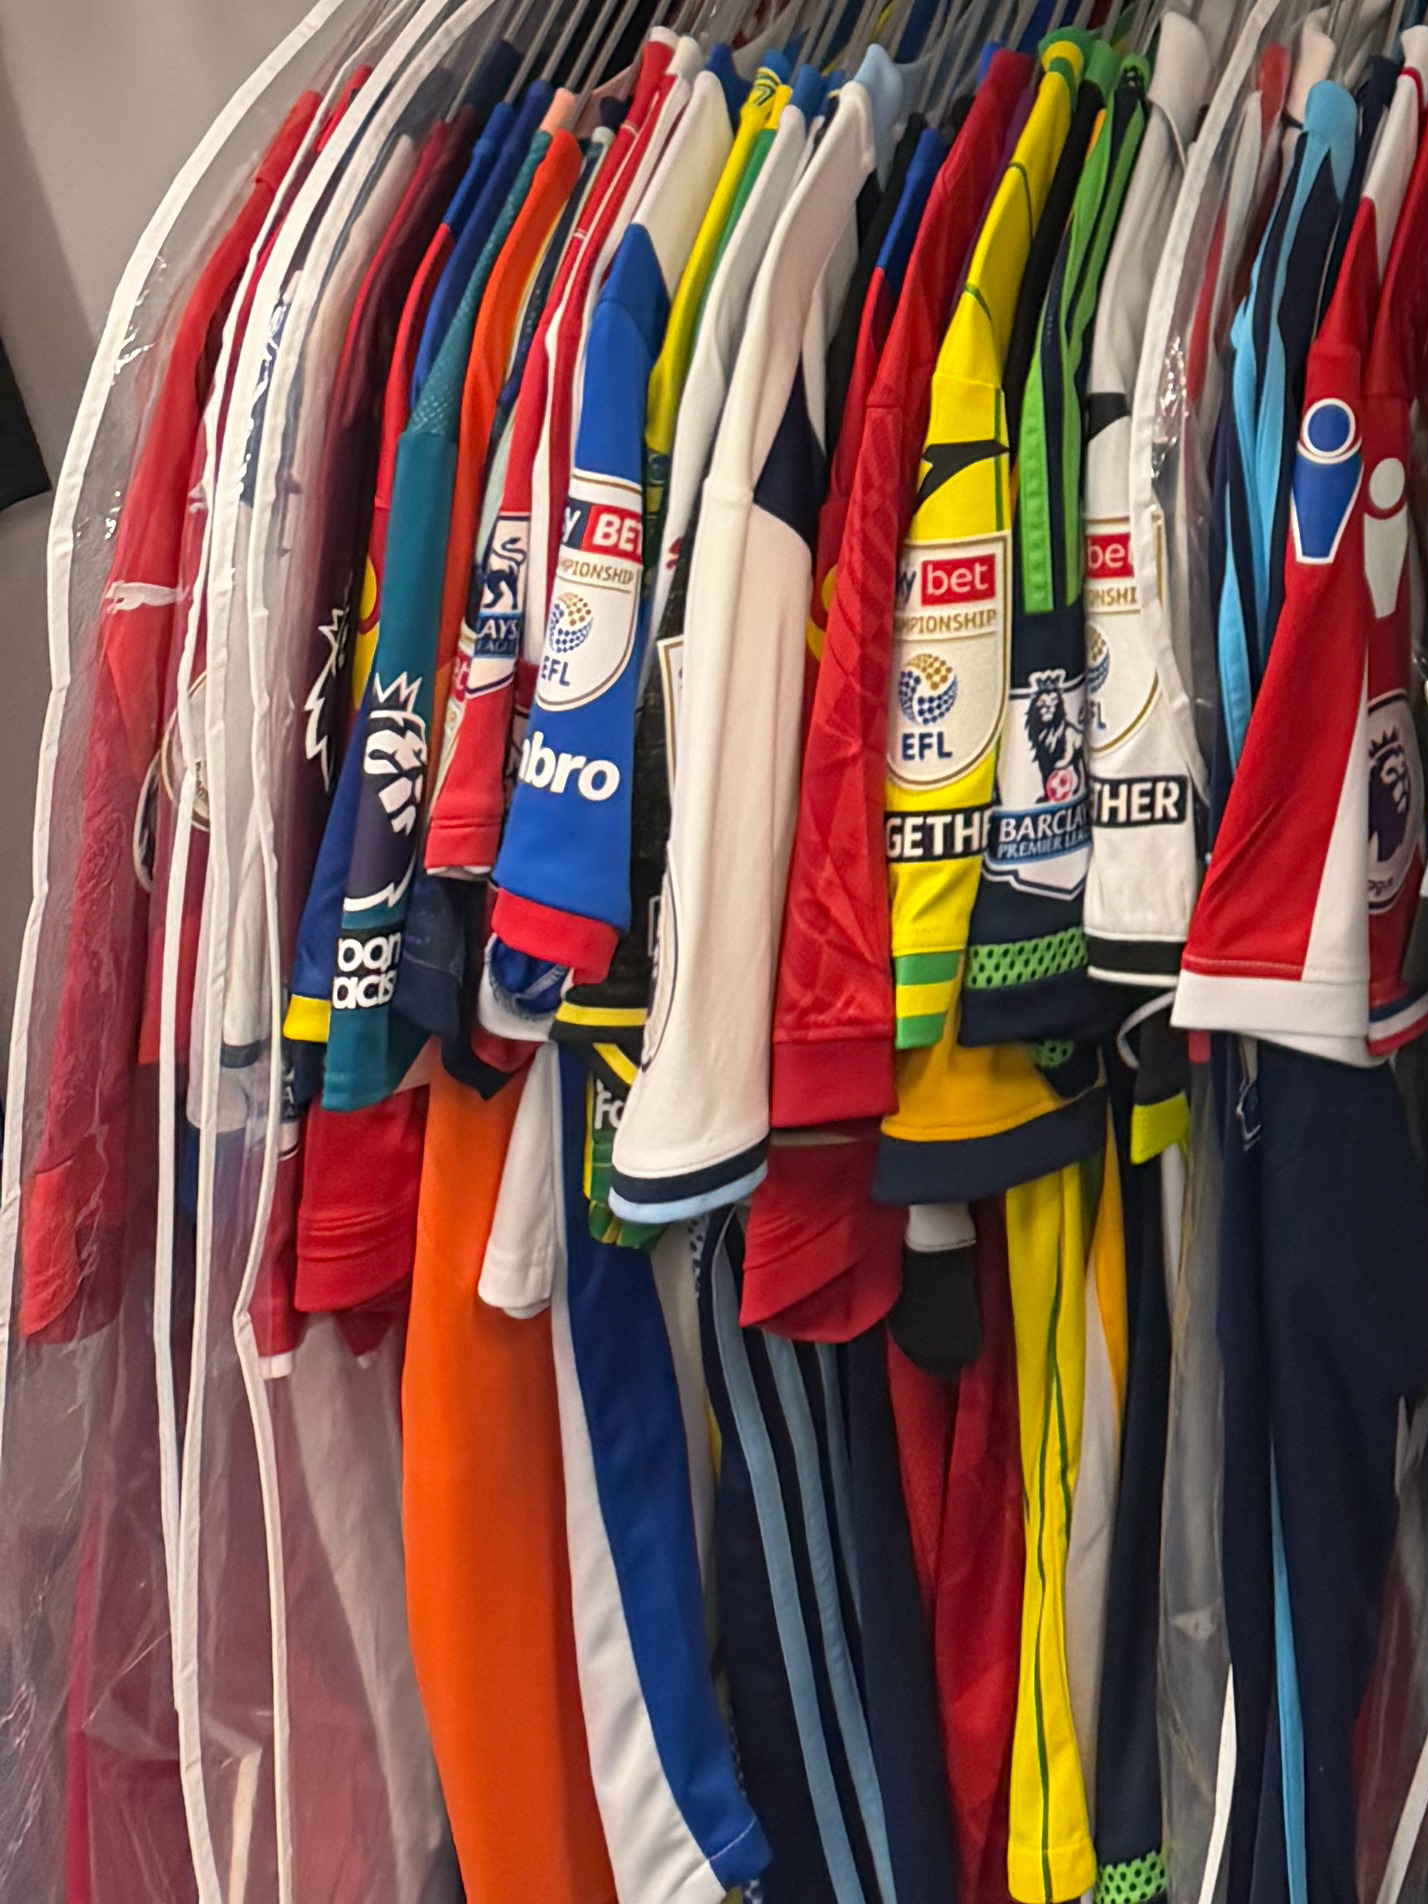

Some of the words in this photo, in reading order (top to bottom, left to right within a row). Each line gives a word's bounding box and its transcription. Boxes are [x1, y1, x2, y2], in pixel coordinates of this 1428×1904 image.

[1087, 543, 1134, 569] be
[926, 562, 990, 596] bet
[902, 730, 953, 761] EFL
